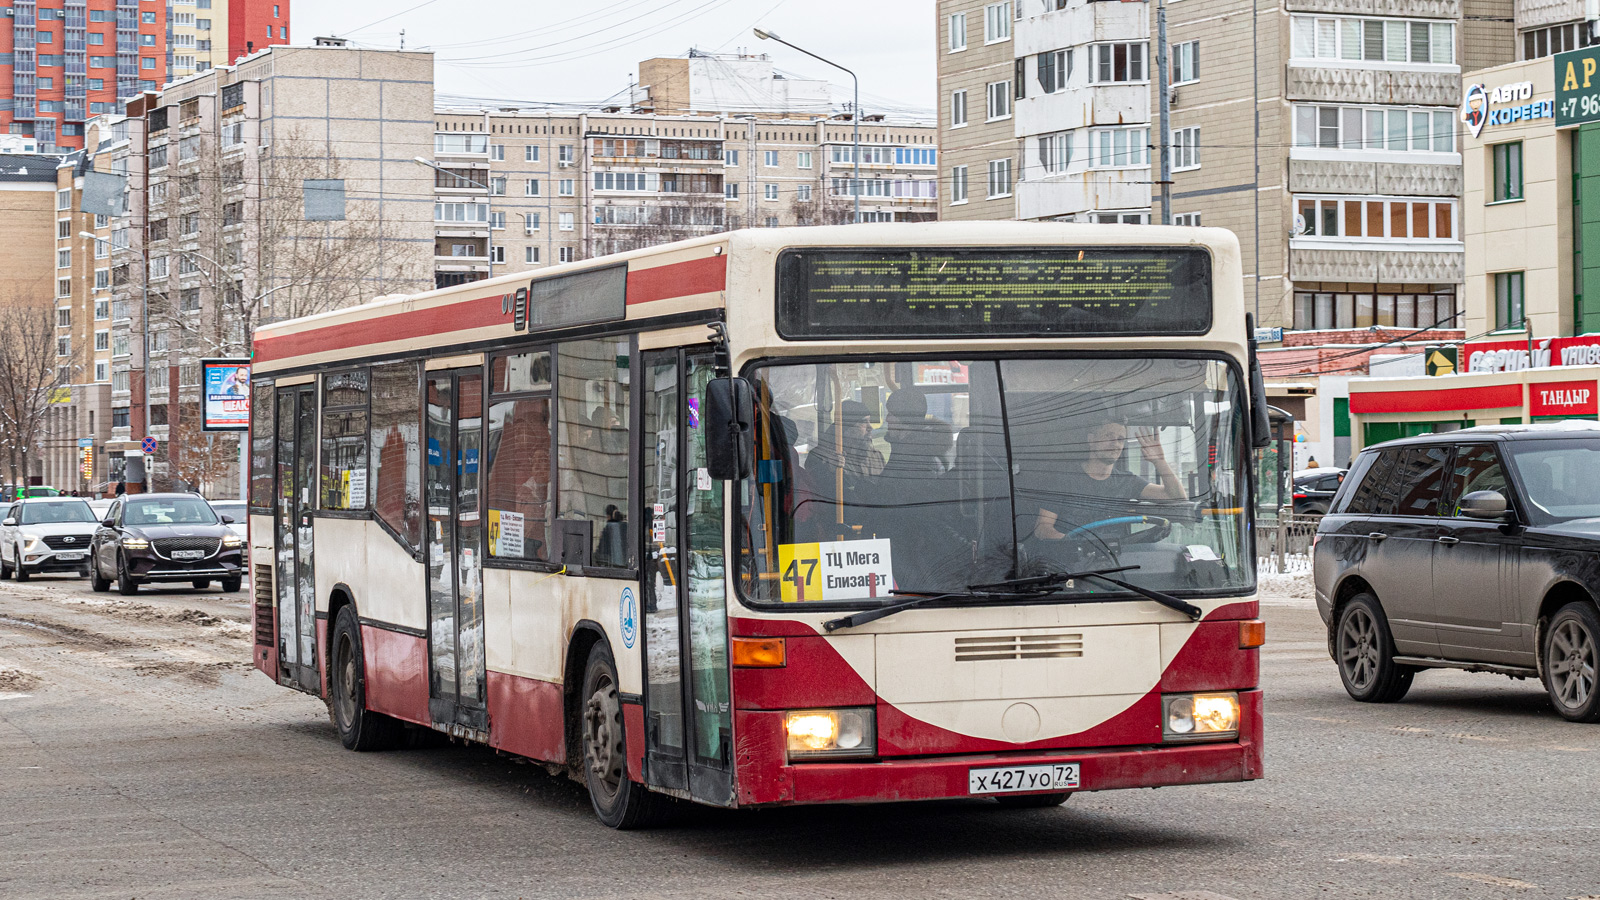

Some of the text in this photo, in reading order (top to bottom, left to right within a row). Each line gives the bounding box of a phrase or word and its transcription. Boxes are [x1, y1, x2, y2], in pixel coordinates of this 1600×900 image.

[1490, 82, 1533, 104] АВТО
[1488, 98, 1554, 126] КОРЕЕЦ
[1560, 97, 1578, 118] +7
[1541, 389, 1590, 407] ТАНДЫР
[825, 551, 880, 569] ТЦ Мега
[782, 558, 819, 587] 47
[977, 767, 1074, 791] Х427УО 72
